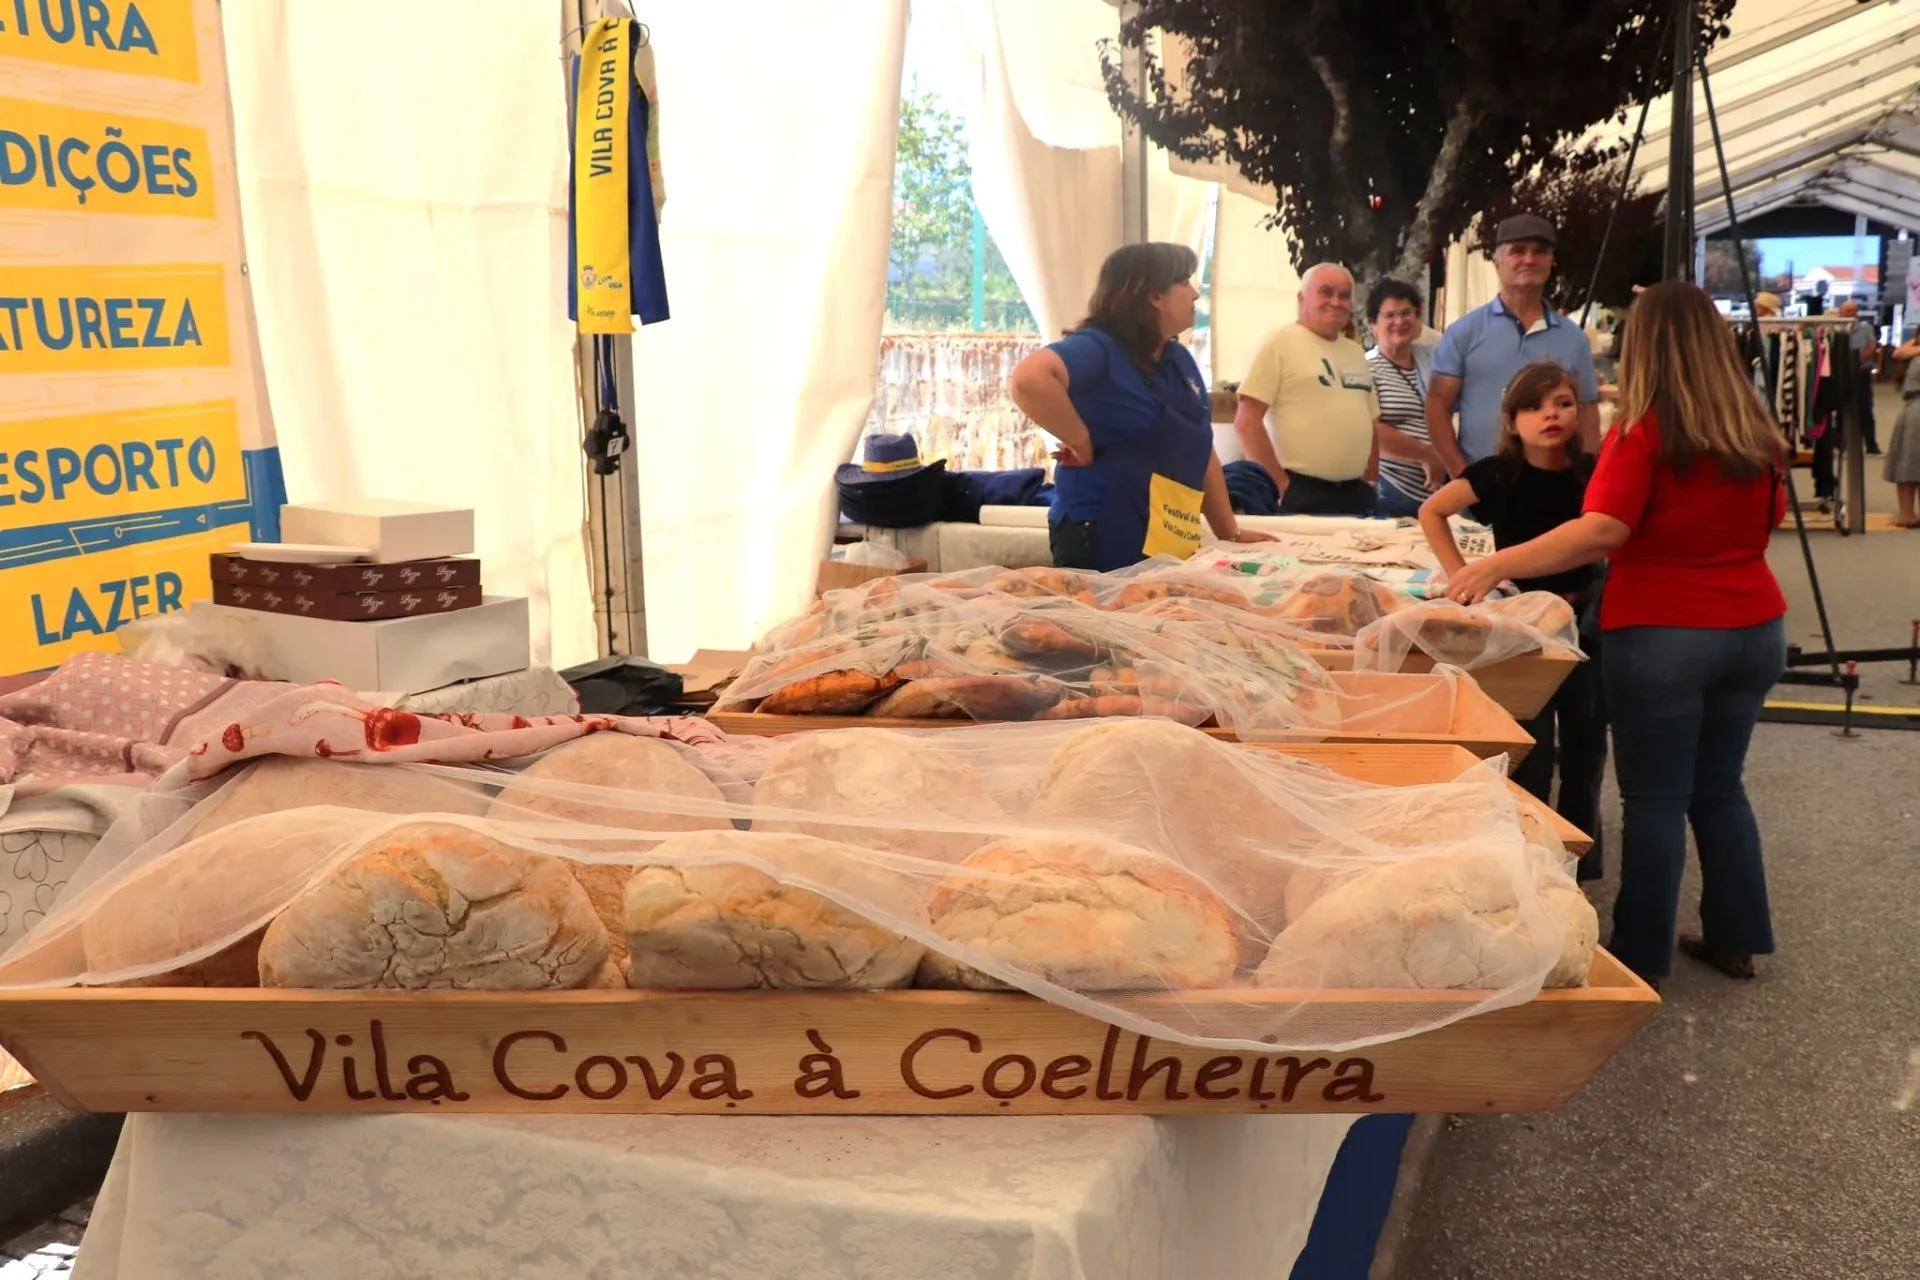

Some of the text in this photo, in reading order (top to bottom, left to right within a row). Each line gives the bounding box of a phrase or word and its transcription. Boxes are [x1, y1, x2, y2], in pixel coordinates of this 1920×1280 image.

[0, 0, 159, 56] TURA
[596, 59, 616, 120] COVA
[0, 126, 198, 205] DIÇÕES
[590, 127, 613, 177] VILA
[0, 297, 203, 350] TUREZA
[31, 571, 183, 646] LAZER
[240, 1019, 1384, 1103] Vila Cova à Coelheira
